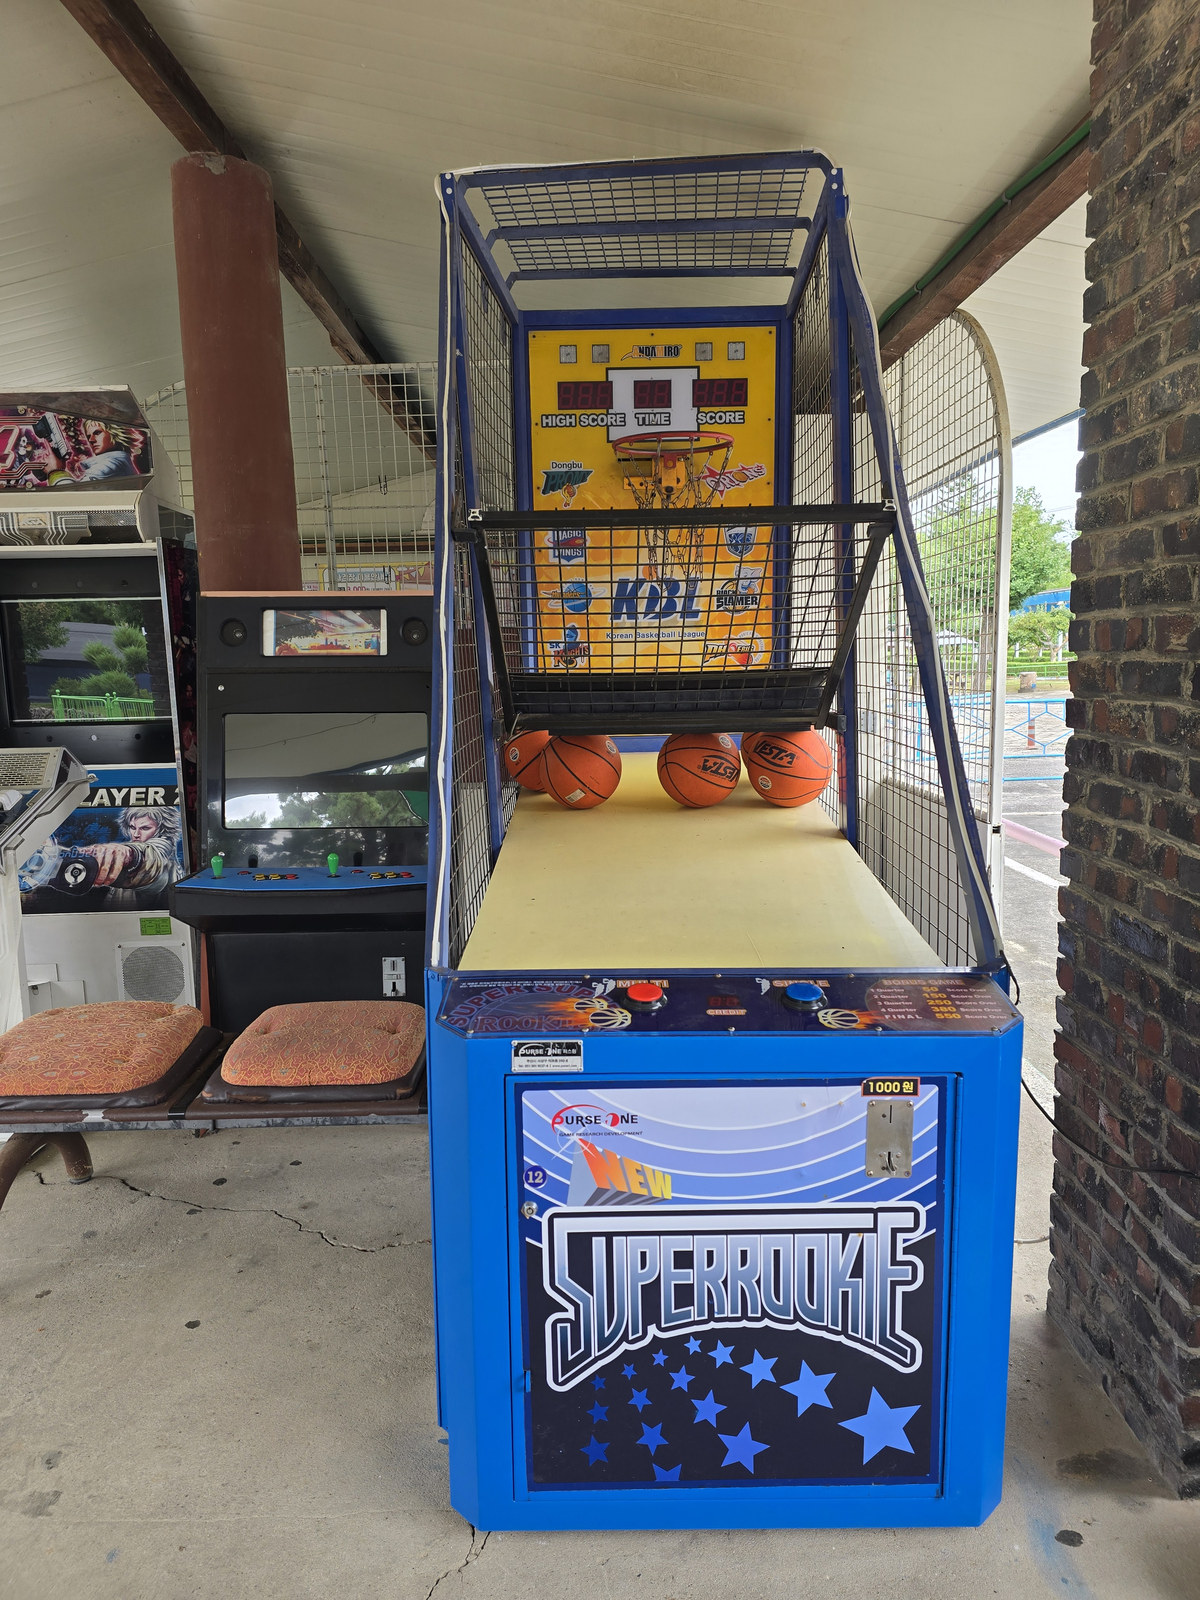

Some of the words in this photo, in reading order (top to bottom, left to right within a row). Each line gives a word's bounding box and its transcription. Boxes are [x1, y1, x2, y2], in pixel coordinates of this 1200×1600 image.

[541, 414, 576, 427] HIGH
[579, 413, 625, 427] SCORE
[635, 412, 670, 425] TIME
[697, 411, 744, 424] SCORE
[551, 461, 583, 470] Dongbu
[610, 577, 701, 621] KBL
[636, 631, 676, 639] Baskeball
[678, 630, 706, 638] League
[701, 758, 739, 783] ESTA
[551, 1108, 602, 1132] PURSE
[578, 1138, 672, 1200] NEW
[527, 1170, 544, 1184] 12
[549, 1208, 918, 1387] SUPERROOKIE
